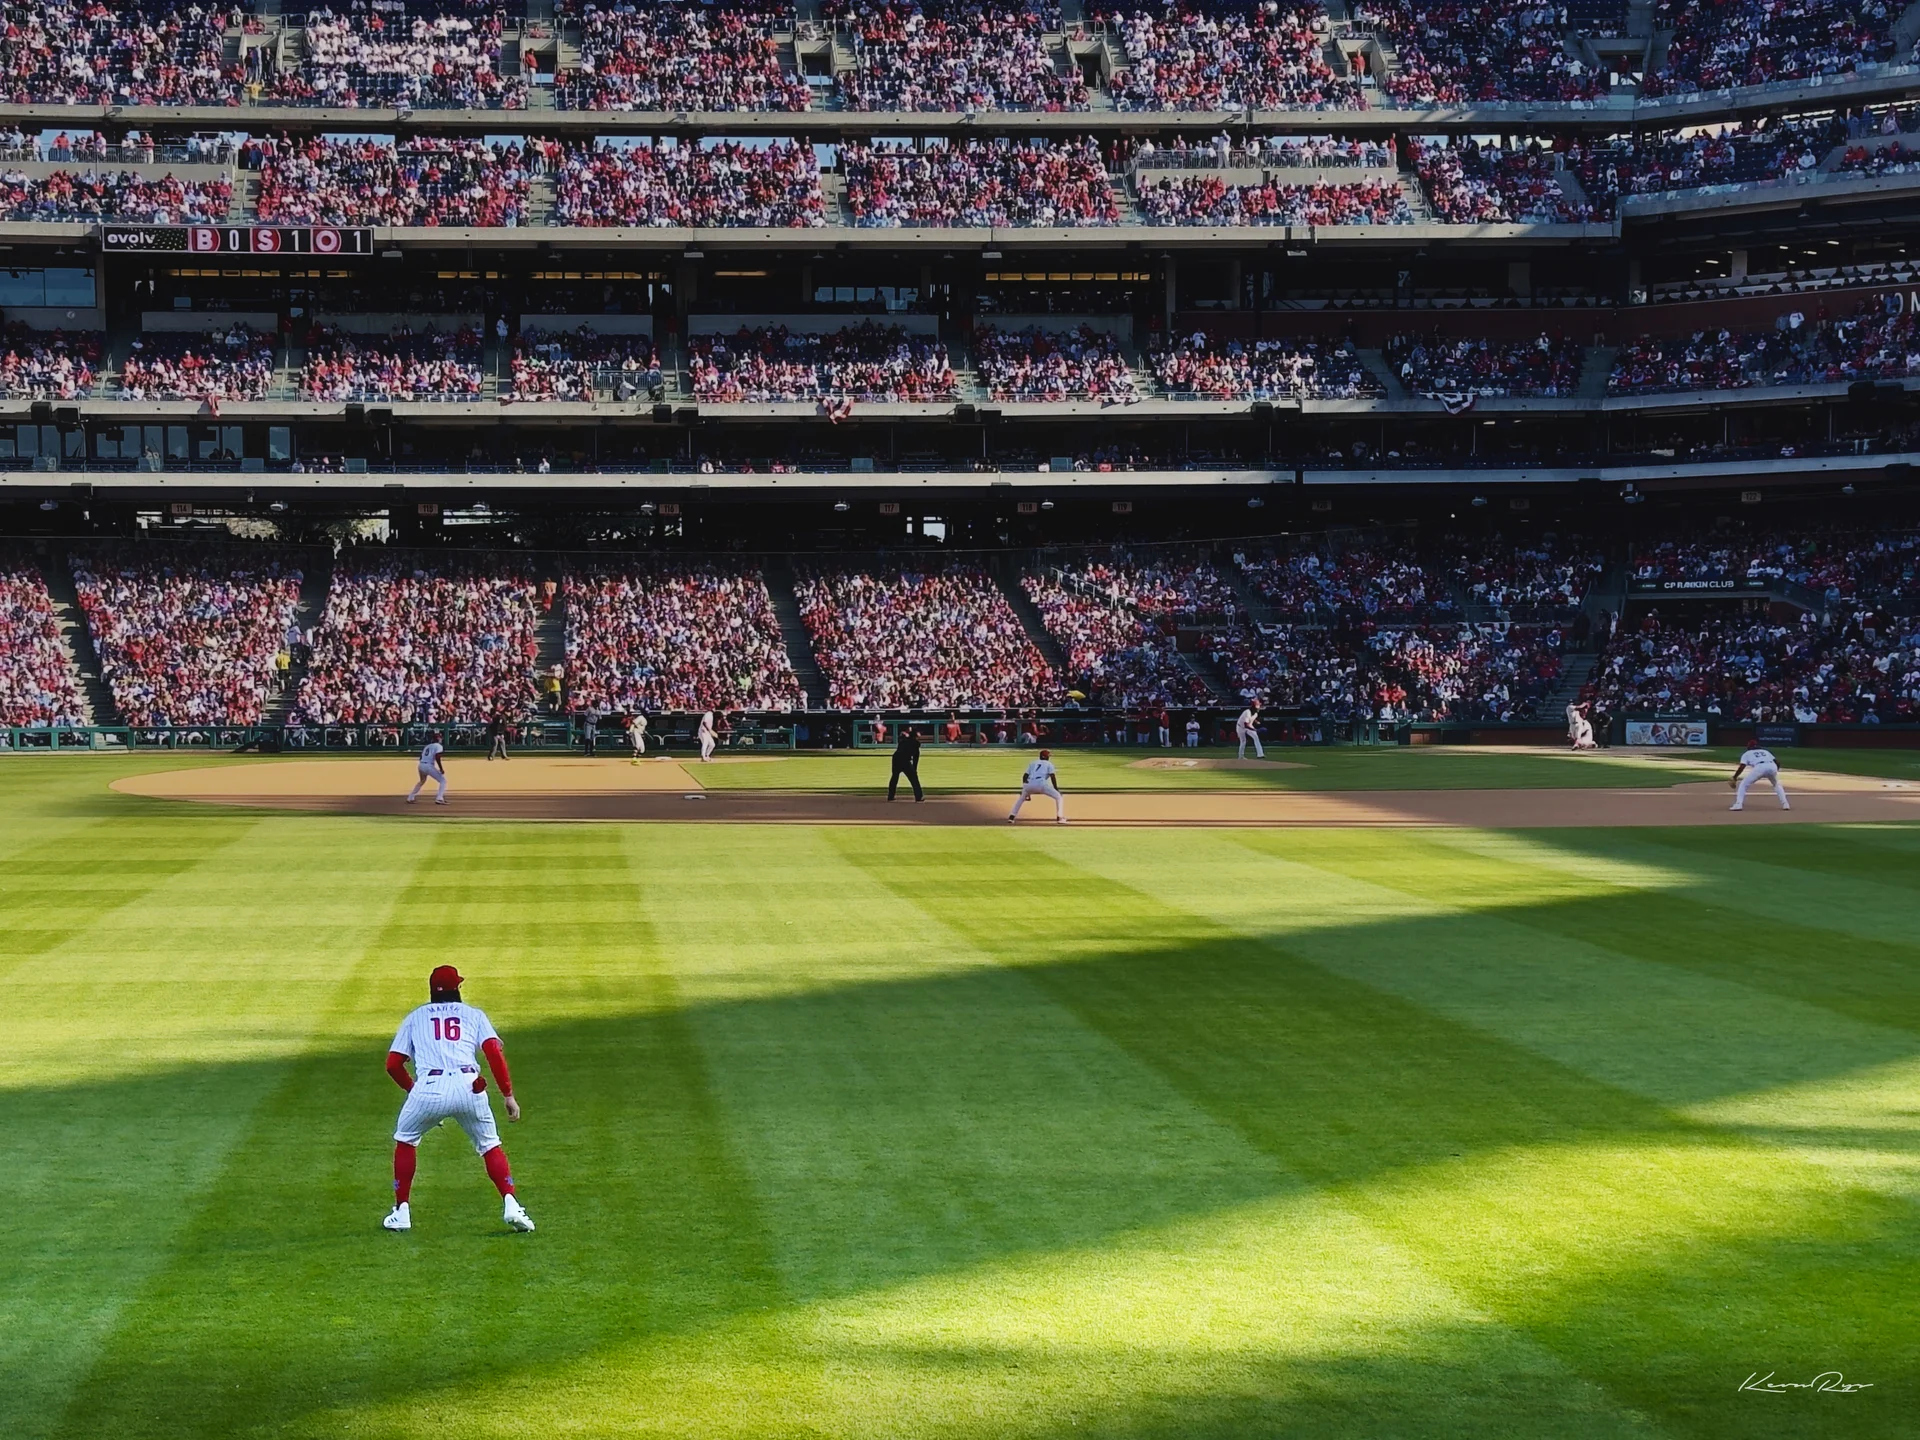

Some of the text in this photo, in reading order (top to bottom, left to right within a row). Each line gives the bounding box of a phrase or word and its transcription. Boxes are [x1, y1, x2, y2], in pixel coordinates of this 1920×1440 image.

[107, 231, 156, 244] evolv
[196, 229, 361, 252] B 0 S 1 O 1
[176, 504, 187, 513] 114
[884, 504, 895, 512] 117
[1664, 581, 1676, 589] CP
[1709, 580, 1734, 588] CLUB
[1035, 764, 1042, 772] 7
[430, 1017, 461, 1041] 16
